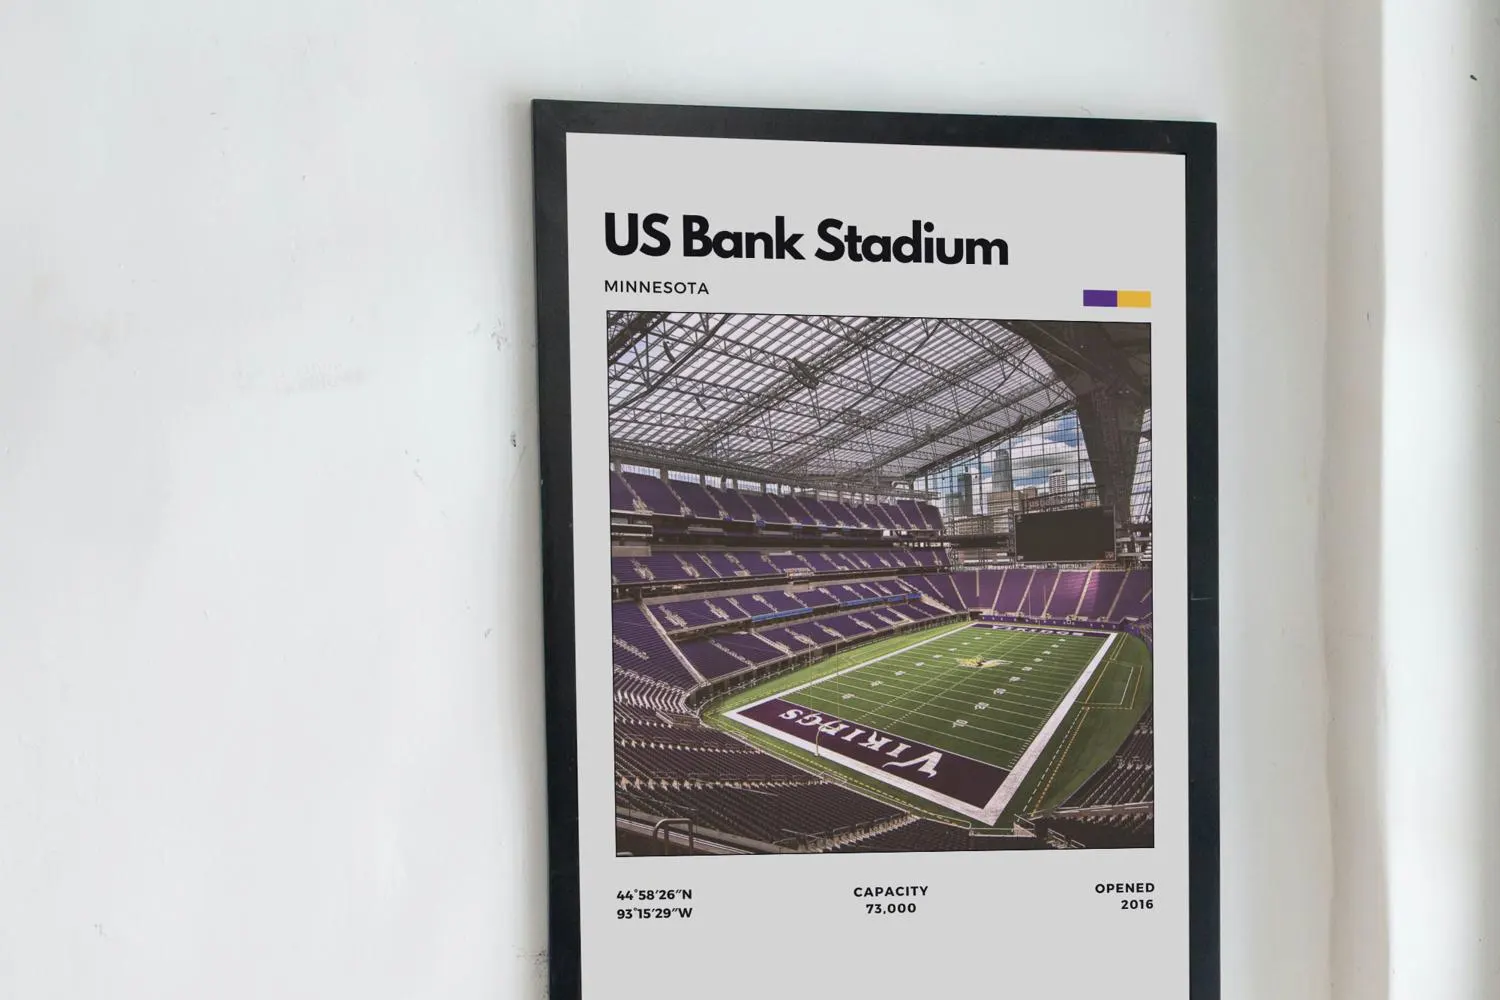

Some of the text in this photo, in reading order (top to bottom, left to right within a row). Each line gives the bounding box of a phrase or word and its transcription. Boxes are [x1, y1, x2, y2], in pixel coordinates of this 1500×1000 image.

[604, 211, 1009, 266] US Bank Stadium
[604, 279, 710, 295] MINNESOTA
[778, 708, 943, 778] VIKINGS
[853, 885, 929, 898] CAPACITY
[1094, 882, 1156, 894] OPENED
[865, 902, 917, 915] 73,000
[1120, 899, 1154, 910] 2016
